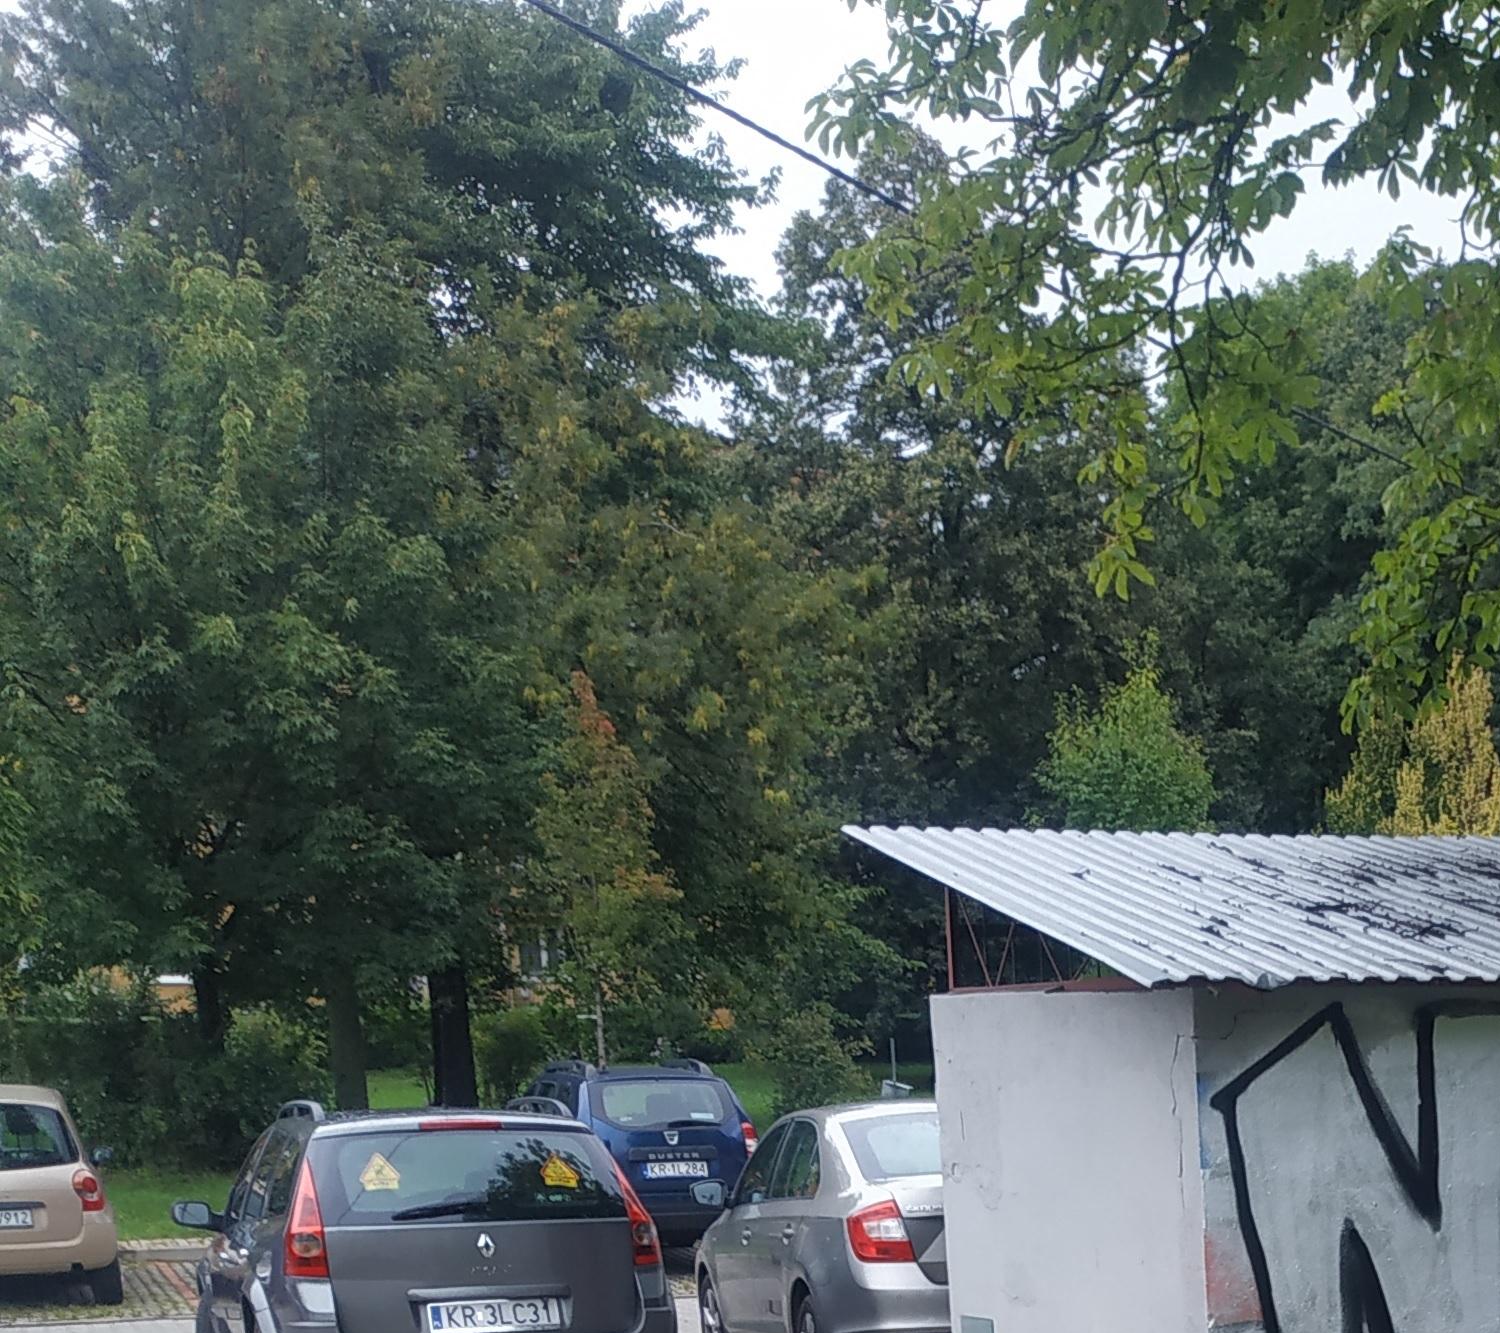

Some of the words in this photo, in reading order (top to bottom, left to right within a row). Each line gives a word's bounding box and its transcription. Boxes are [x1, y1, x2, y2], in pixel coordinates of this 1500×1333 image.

[648, 1152, 700, 1160] DUSTER
[650, 1163, 667, 1175] KR
[671, 1163, 705, 1175] 1L284
[446, 1305, 477, 1328] KR
[484, 1299, 551, 1325] 3LC31
